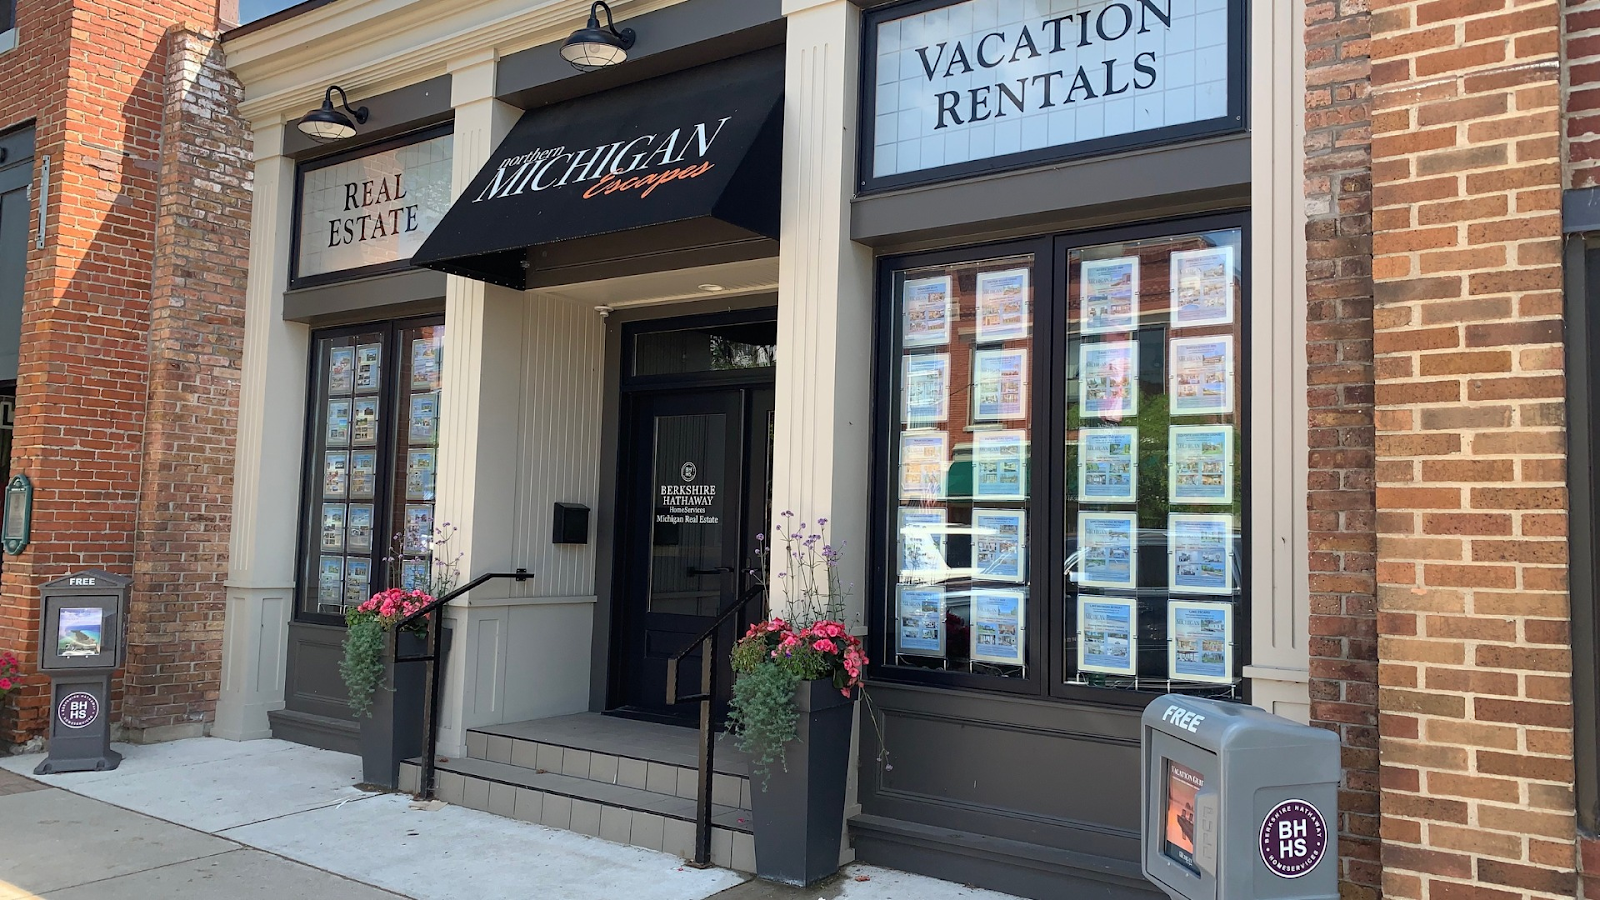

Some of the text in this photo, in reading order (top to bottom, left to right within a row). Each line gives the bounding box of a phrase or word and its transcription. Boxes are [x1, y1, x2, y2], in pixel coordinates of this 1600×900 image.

[915, 0, 1171, 81] VACATION
[934, 52, 1156, 130] RENTALS
[472, 116, 732, 203] MICHIGAN
[501, 145, 565, 169] northern
[582, 161, 715, 199] Escapes
[343, 173, 407, 211] REAL
[328, 204, 419, 248] ESTATE
[660, 485, 716, 495] BERKSHIRE
[662, 496, 714, 506] HATHAWAY
[656, 514, 719, 524] Michigan Real Estate
[69, 577, 96, 586] FREE
[70, 701, 88, 710] BH
[70, 710, 87, 719] HS
[1162, 705, 1206, 733] FREE
[1264, 805, 1322, 844] BERKSHIRE HATHAWAY
[1279, 819, 1307, 839] BH
[1279, 838, 1308, 859] HS
[1269, 850, 1319, 872] HOMESERVICES
